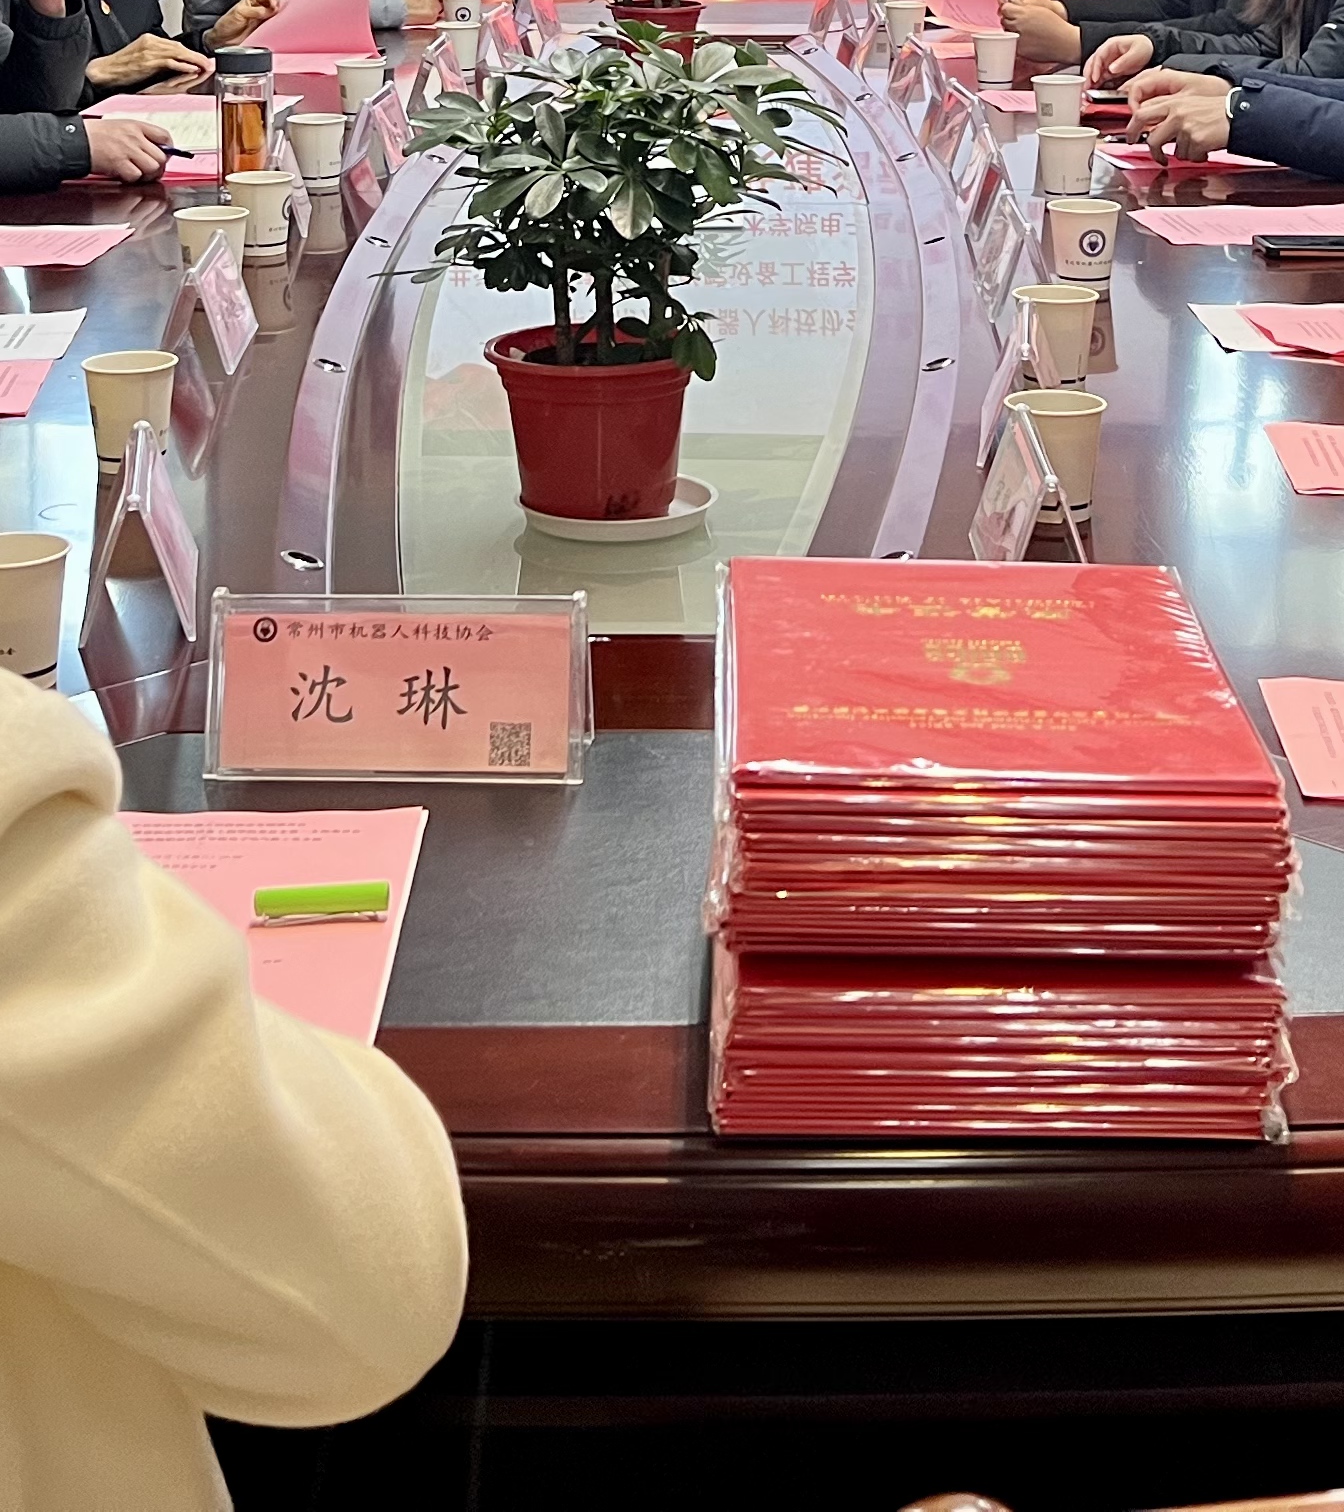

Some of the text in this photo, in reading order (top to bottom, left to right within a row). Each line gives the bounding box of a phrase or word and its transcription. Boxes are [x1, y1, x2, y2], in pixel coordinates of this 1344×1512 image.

[287, 622, 494, 642] 常州市机器人科技协会
